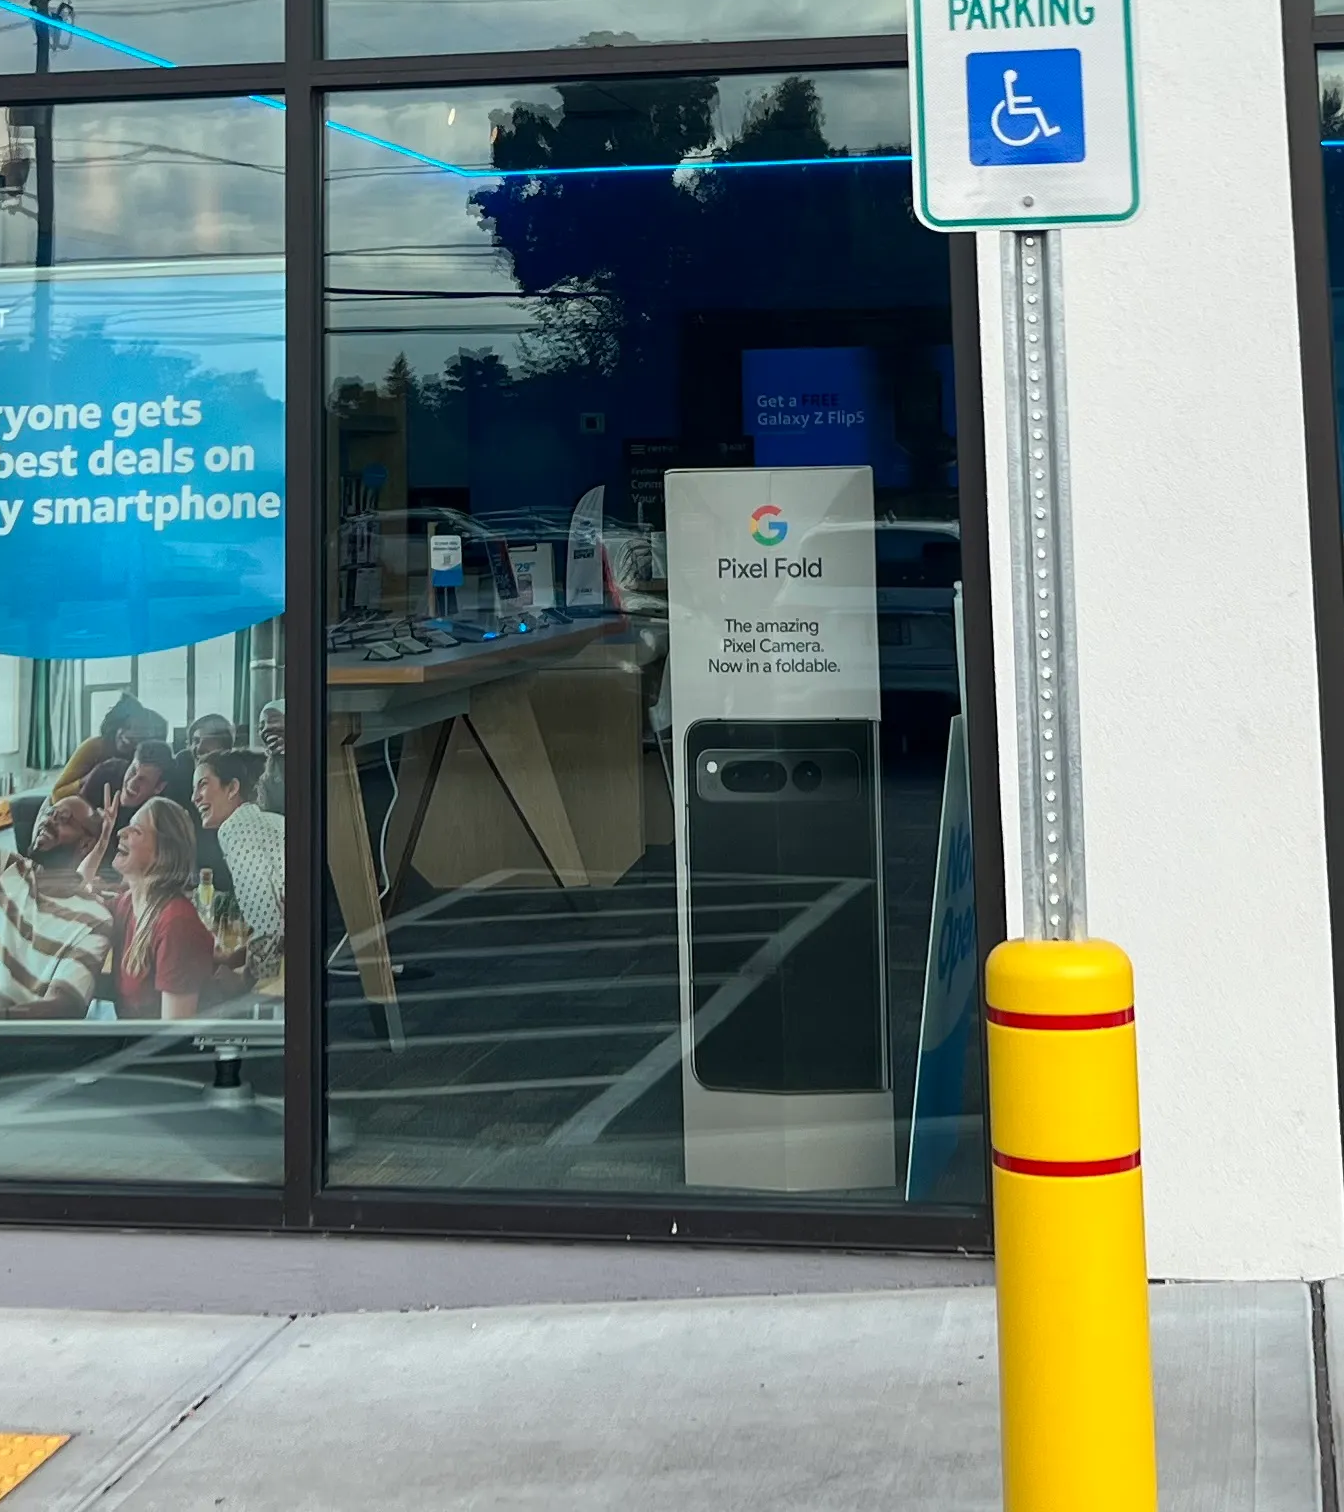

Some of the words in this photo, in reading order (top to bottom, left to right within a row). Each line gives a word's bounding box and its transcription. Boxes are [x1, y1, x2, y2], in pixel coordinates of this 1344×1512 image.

[757, 395, 786, 408] Get
[789, 397, 797, 407] a
[801, 393, 839, 407] FREE
[112, 395, 202, 438] gets
[757, 412, 810, 428] Galaxy
[814, 412, 824, 425] Z
[88, 438, 194, 477] deals
[204, 444, 255, 472] on
[32, 485, 281, 531] smartphone
[718, 558, 767, 579] Pixel
[775, 557, 823, 579] Fold
[725, 619, 752, 634] The
[755, 619, 819, 636] amazing
[723, 639, 757, 653] Pixel
[759, 638, 824, 653] Camera.
[708, 659, 742, 673] Now
[746, 659, 759, 673] in
[762, 662, 772, 673] a
[775, 658, 840, 673] foldable.
[945, 821, 972, 900] No
[938, 904, 974, 995] Ope
